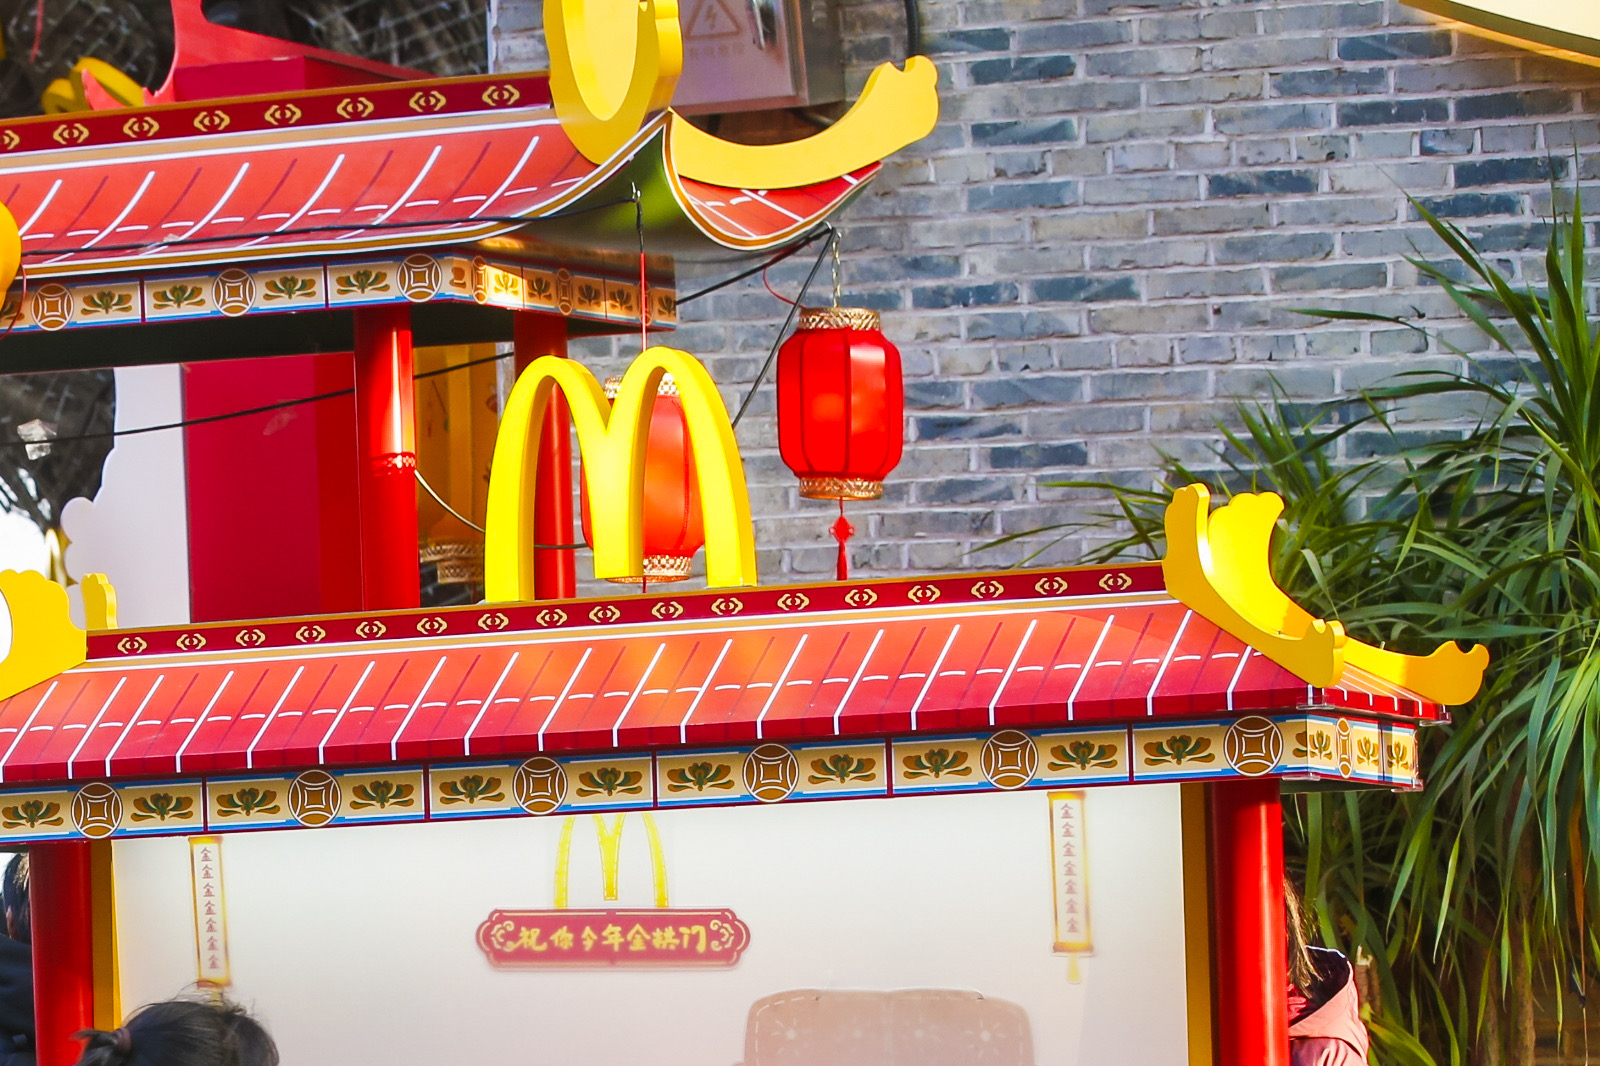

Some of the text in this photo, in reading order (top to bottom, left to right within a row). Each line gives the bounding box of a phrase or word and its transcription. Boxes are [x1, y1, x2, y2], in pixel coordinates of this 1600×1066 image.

[513, 923, 708, 954] 祝你今年金拱门
